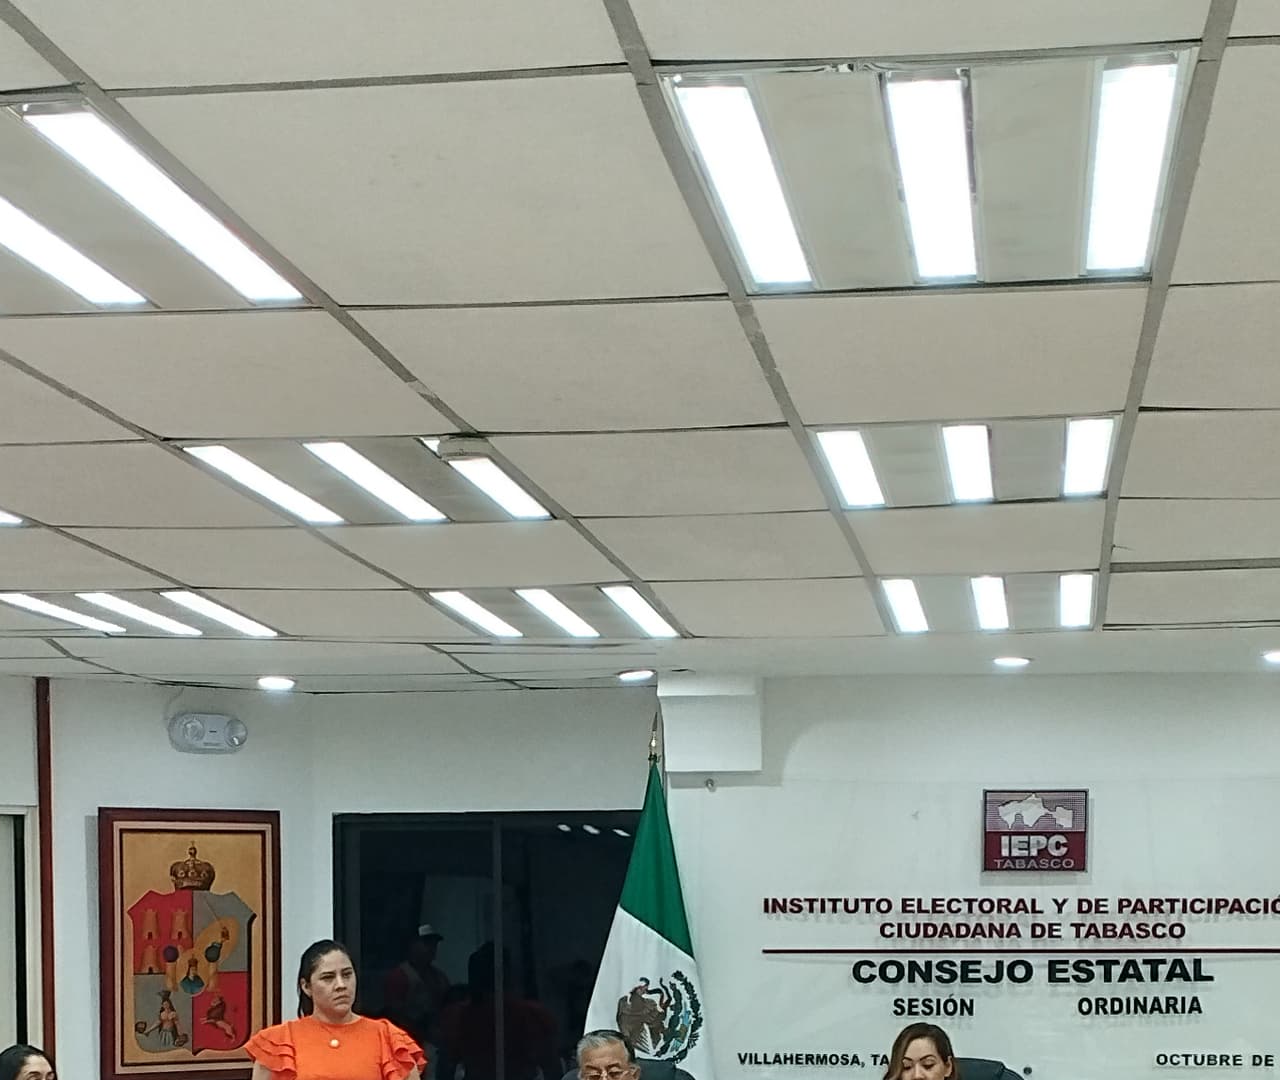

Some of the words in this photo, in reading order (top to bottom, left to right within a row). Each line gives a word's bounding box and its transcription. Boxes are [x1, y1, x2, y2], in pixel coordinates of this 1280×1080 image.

[1000, 834, 1068, 857] IEPC
[993, 858, 1075, 869] TABASCO
[762, 898, 893, 914] INSTITUTO
[900, 898, 1044, 914] ELECTORAL
[1052, 898, 1069, 914] Y
[1077, 898, 1109, 914] DE
[879, 922, 1022, 939] CIUDADANA
[1030, 922, 1062, 939] DE
[1070, 922, 1187, 939] TABASCO
[852, 959, 1034, 984] CONSEJO
[1047, 957, 1215, 983] ESTATAL
[892, 994, 974, 1016] SESIÓN
[1077, 996, 1203, 1015] ORDINARIA
[737, 1052, 866, 1068] VILLAHERMOSA,
[1155, 1053, 1243, 1066] OCTUBRE
[1252, 1054, 1274, 1067] DE
